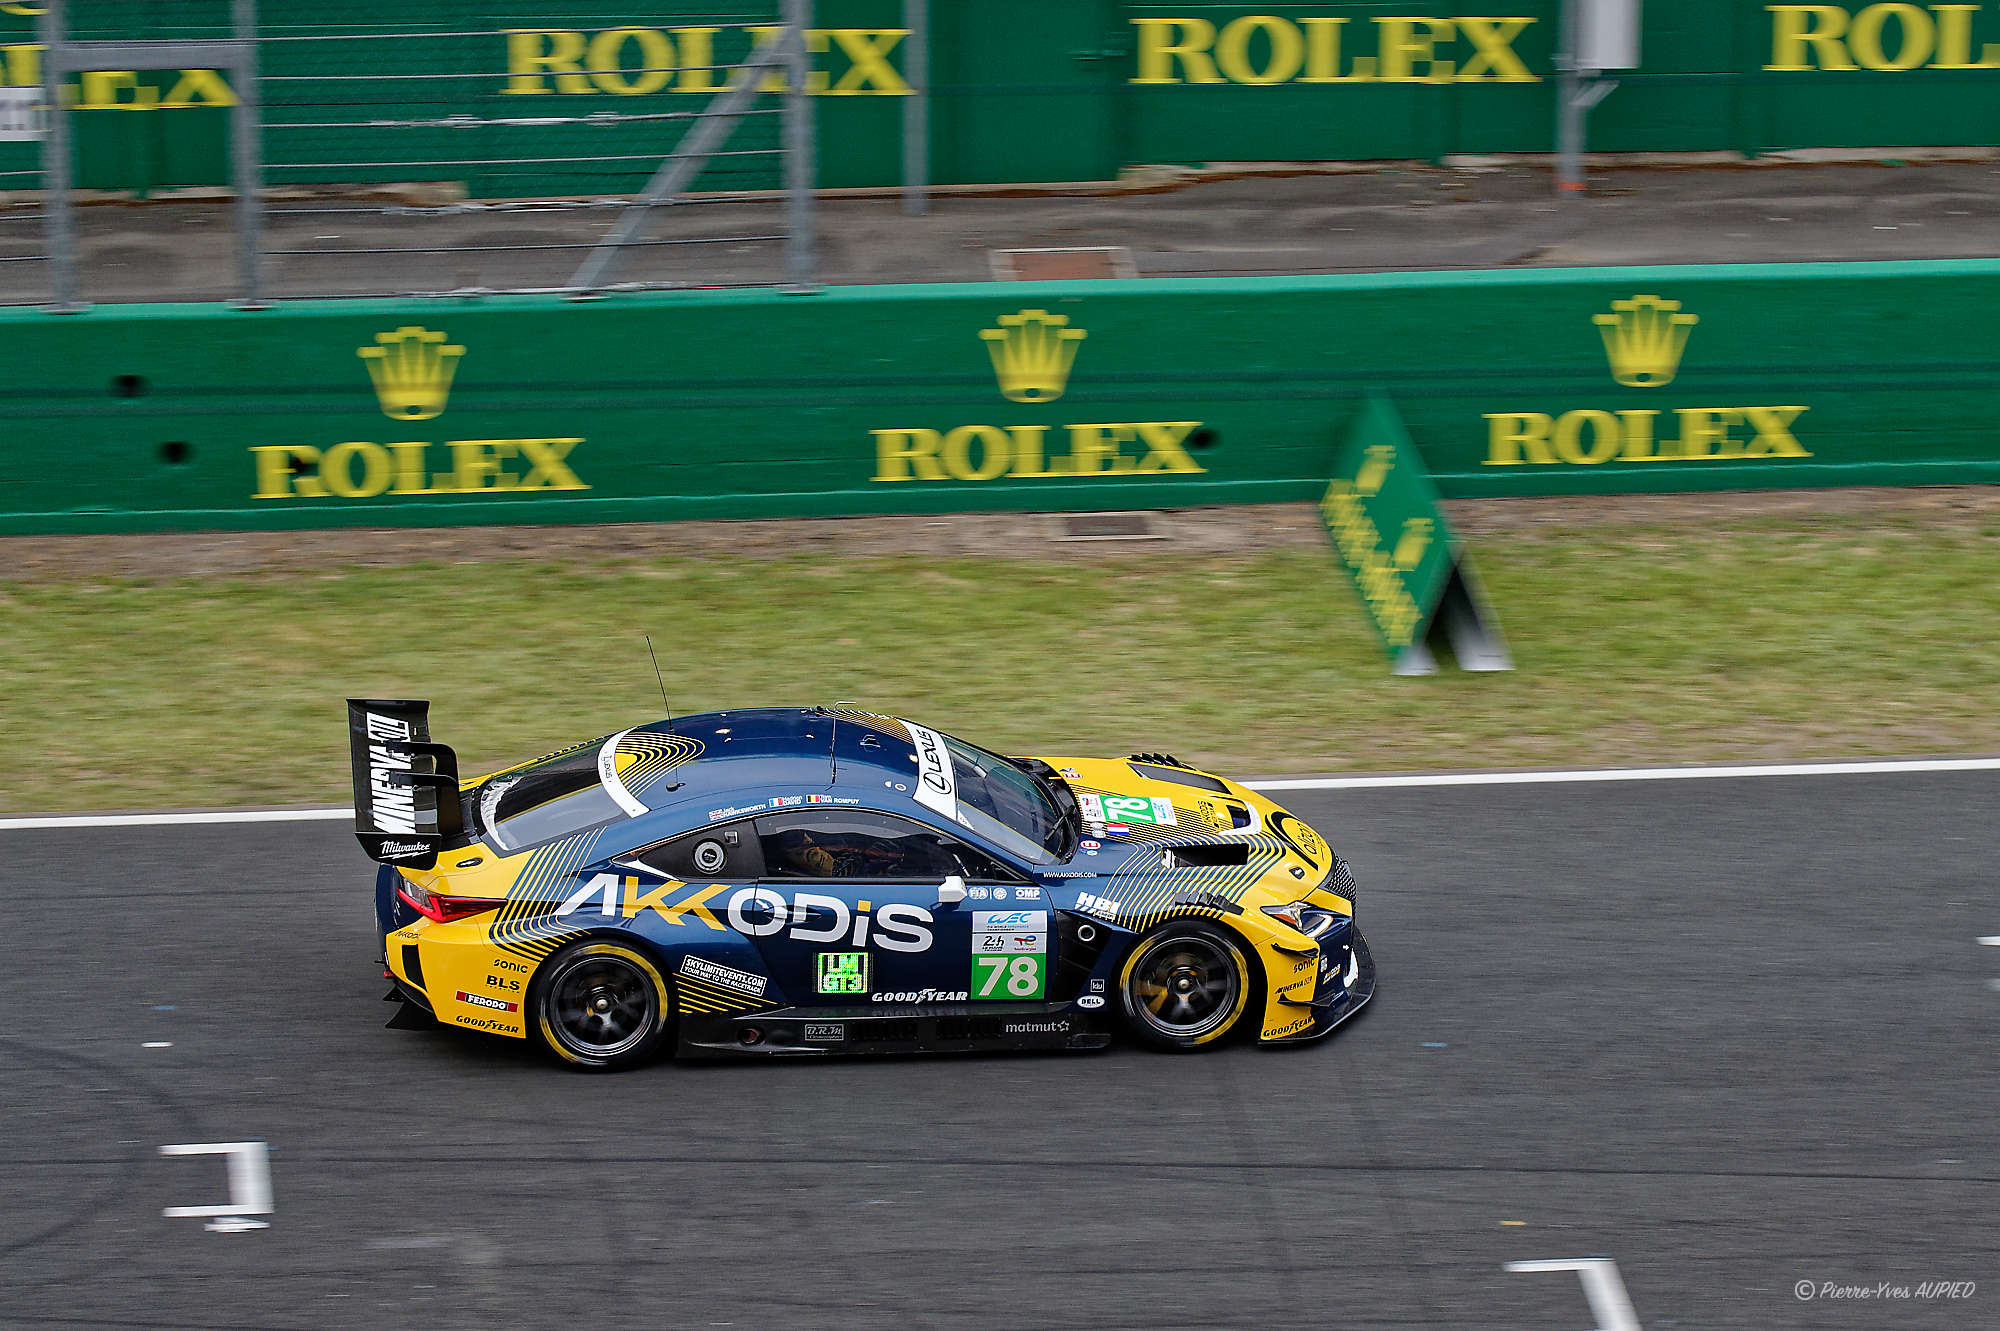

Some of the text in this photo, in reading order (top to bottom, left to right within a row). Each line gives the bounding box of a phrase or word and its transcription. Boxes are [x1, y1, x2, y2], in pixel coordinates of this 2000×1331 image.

[1129, 15, 1541, 85] ROLEX
[1762, 3, 2000, 71] ROL
[501, 26, 919, 97] ROLEX
[1481, 405, 1814, 467] ROLEX
[868, 420, 1208, 482] ROLEX
[249, 436, 592, 500] ROLEX
[916, 729, 942, 773] LEXUS
[1103, 797, 1153, 821] 78
[380, 840, 431, 855] Milwaukee
[1016, 889, 1041, 898] OMP
[987, 912, 1032, 924] WEC
[486, 974, 520, 991] BLS
[686, 958, 764, 988] SKYLIMITEVENTS.COM
[699, 970, 713, 979] WAY
[712, 974, 720, 982] TO
[730, 980, 762, 994] RACETRACK
[823, 973, 863, 991] GT3
[978, 956, 1039, 997] 78
[467, 994, 506, 1010] FERODO
[1005, 1022, 1057, 1033] matmut
